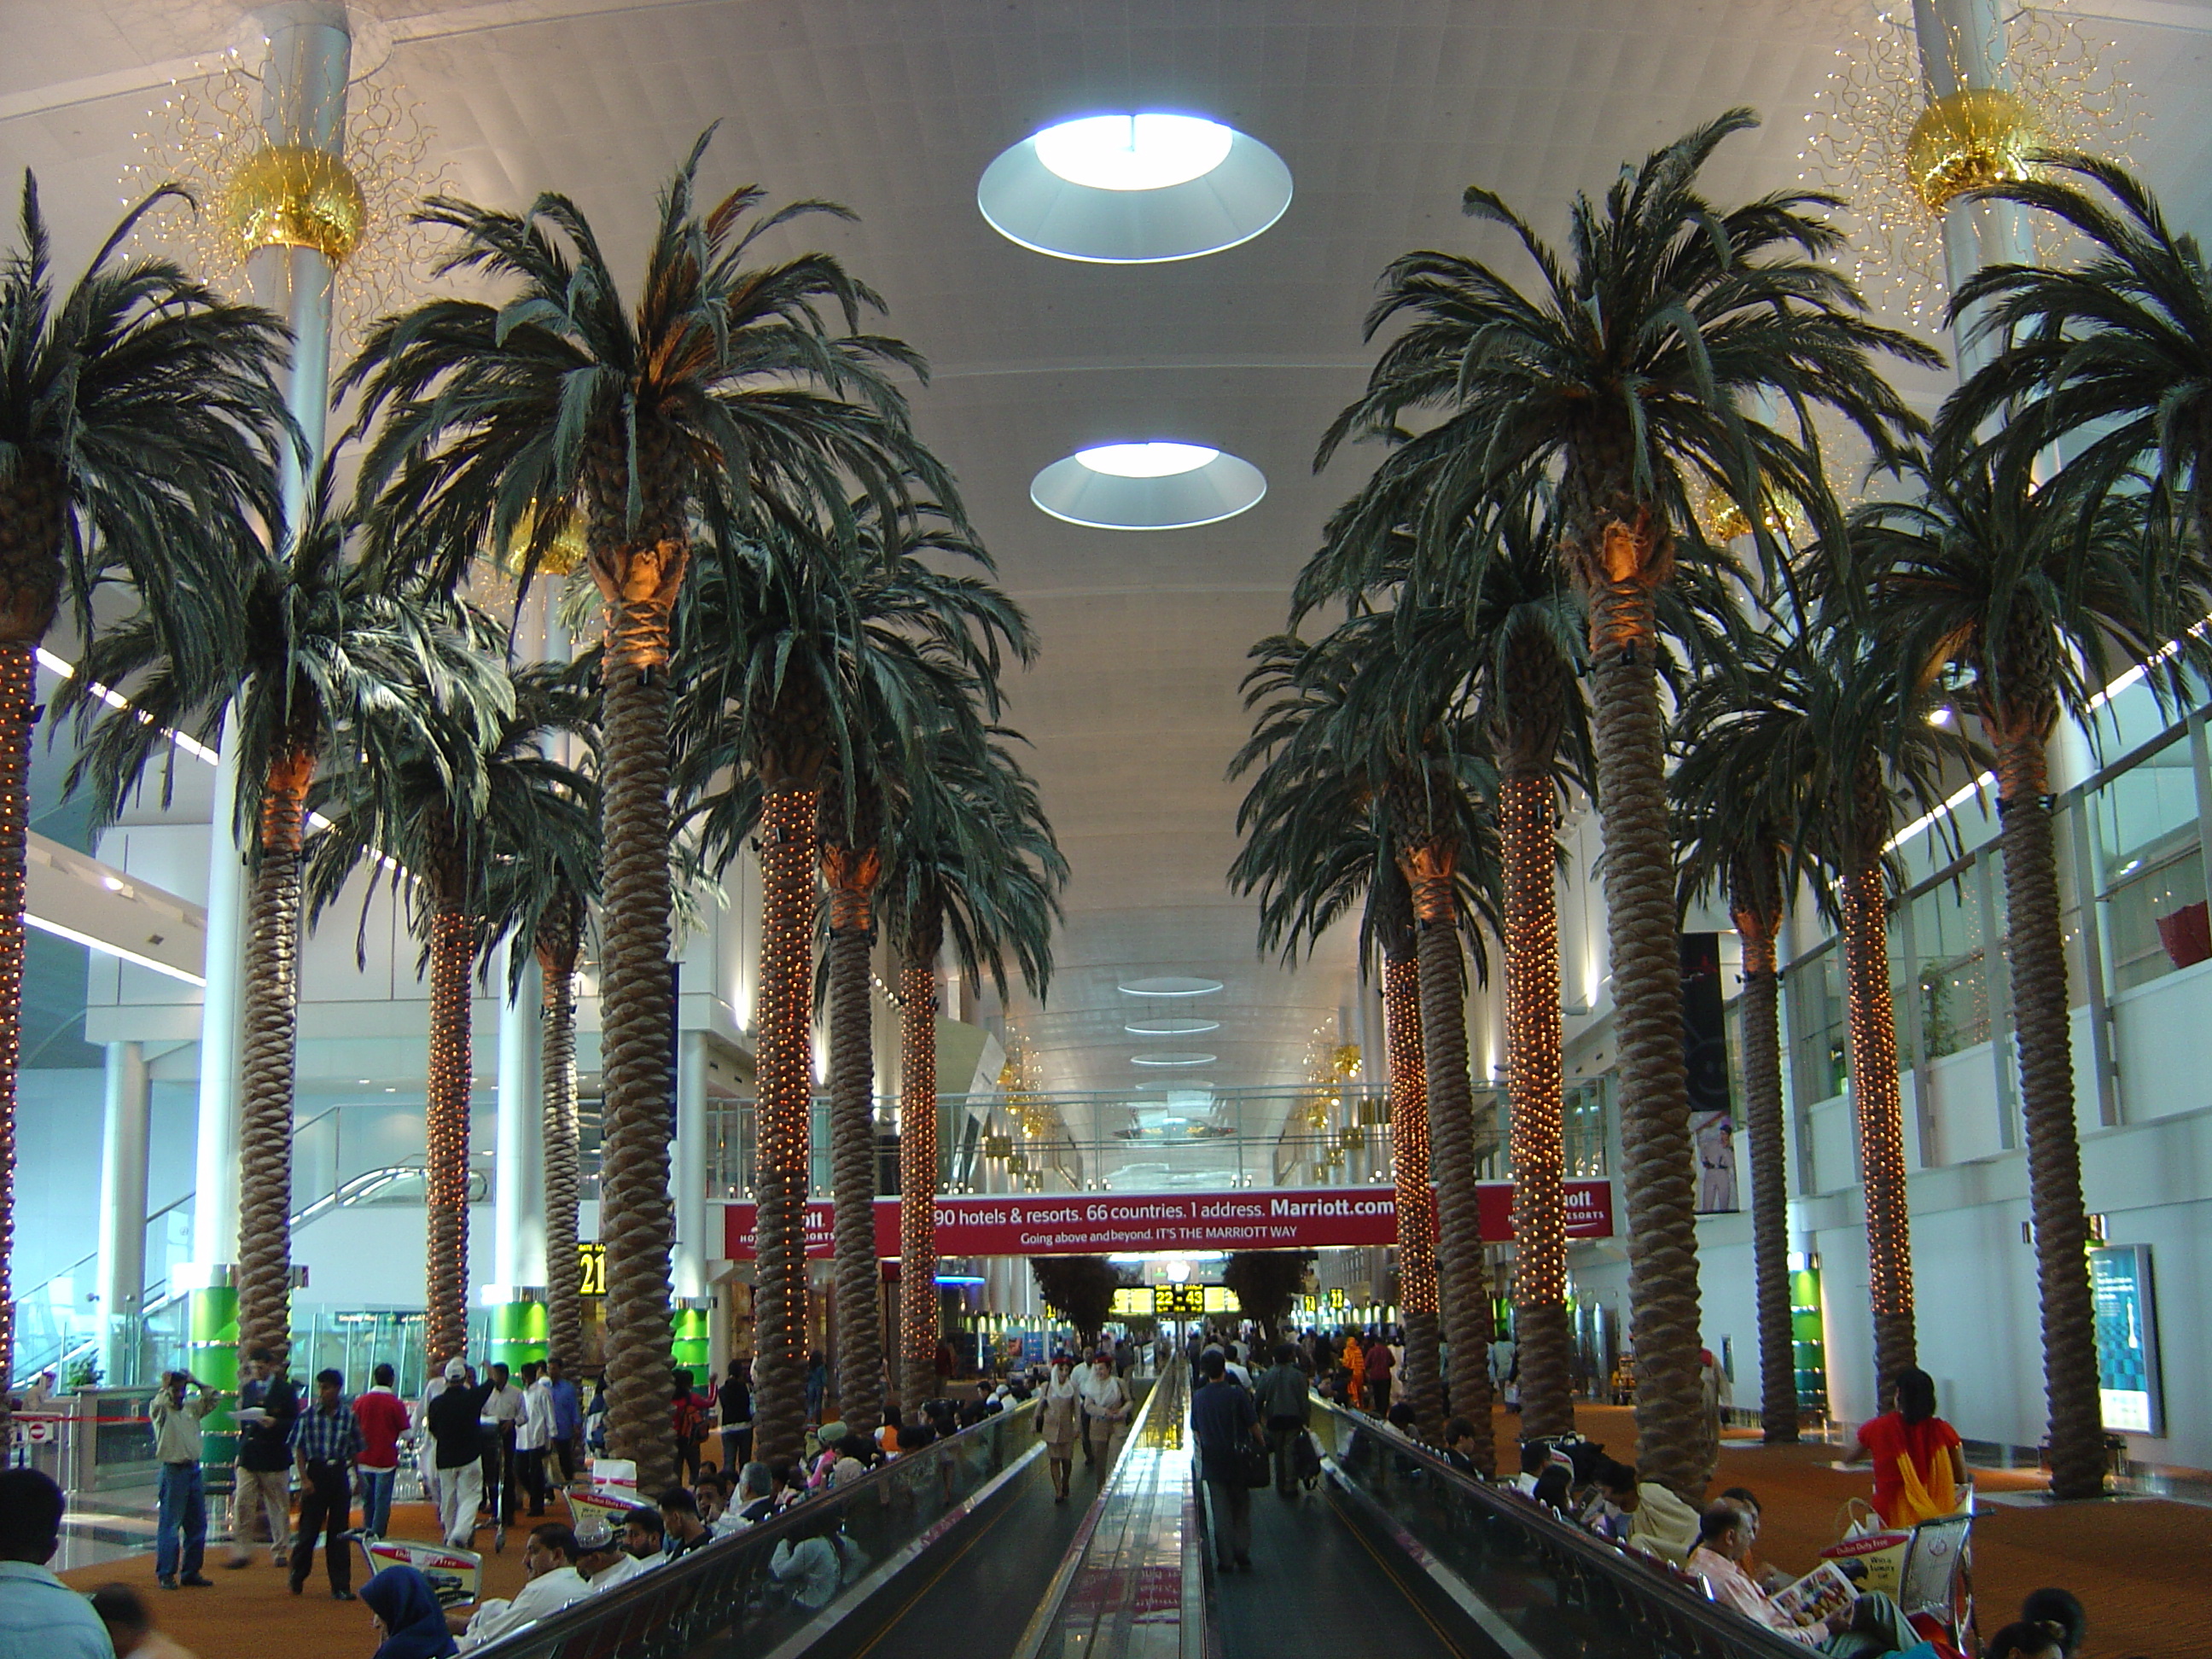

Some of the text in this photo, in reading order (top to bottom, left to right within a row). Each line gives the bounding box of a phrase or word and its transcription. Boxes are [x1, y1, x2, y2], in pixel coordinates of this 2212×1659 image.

[959, 1208, 1006, 1225] hotels
[1010, 1207, 1022, 1224] &
[1027, 1207, 1083, 1224] resorts.
[1086, 1204, 1108, 1221] 66
[1110, 1202, 1187, 1220] countries.
[1190, 1202, 1196, 1218] 1
[1201, 1201, 1266, 1218] address.
[1271, 1197, 1394, 1217] Marriott.com
[1566, 1210, 1604, 1220] ESORTS
[1021, 1225, 1297, 1246] Going above and beyond. IT'S THE MARRIOTT WAY
[580, 1253, 607, 1294] 21
[1155, 1291, 1173, 1305] 22
[1185, 1290, 1203, 1305] 43
